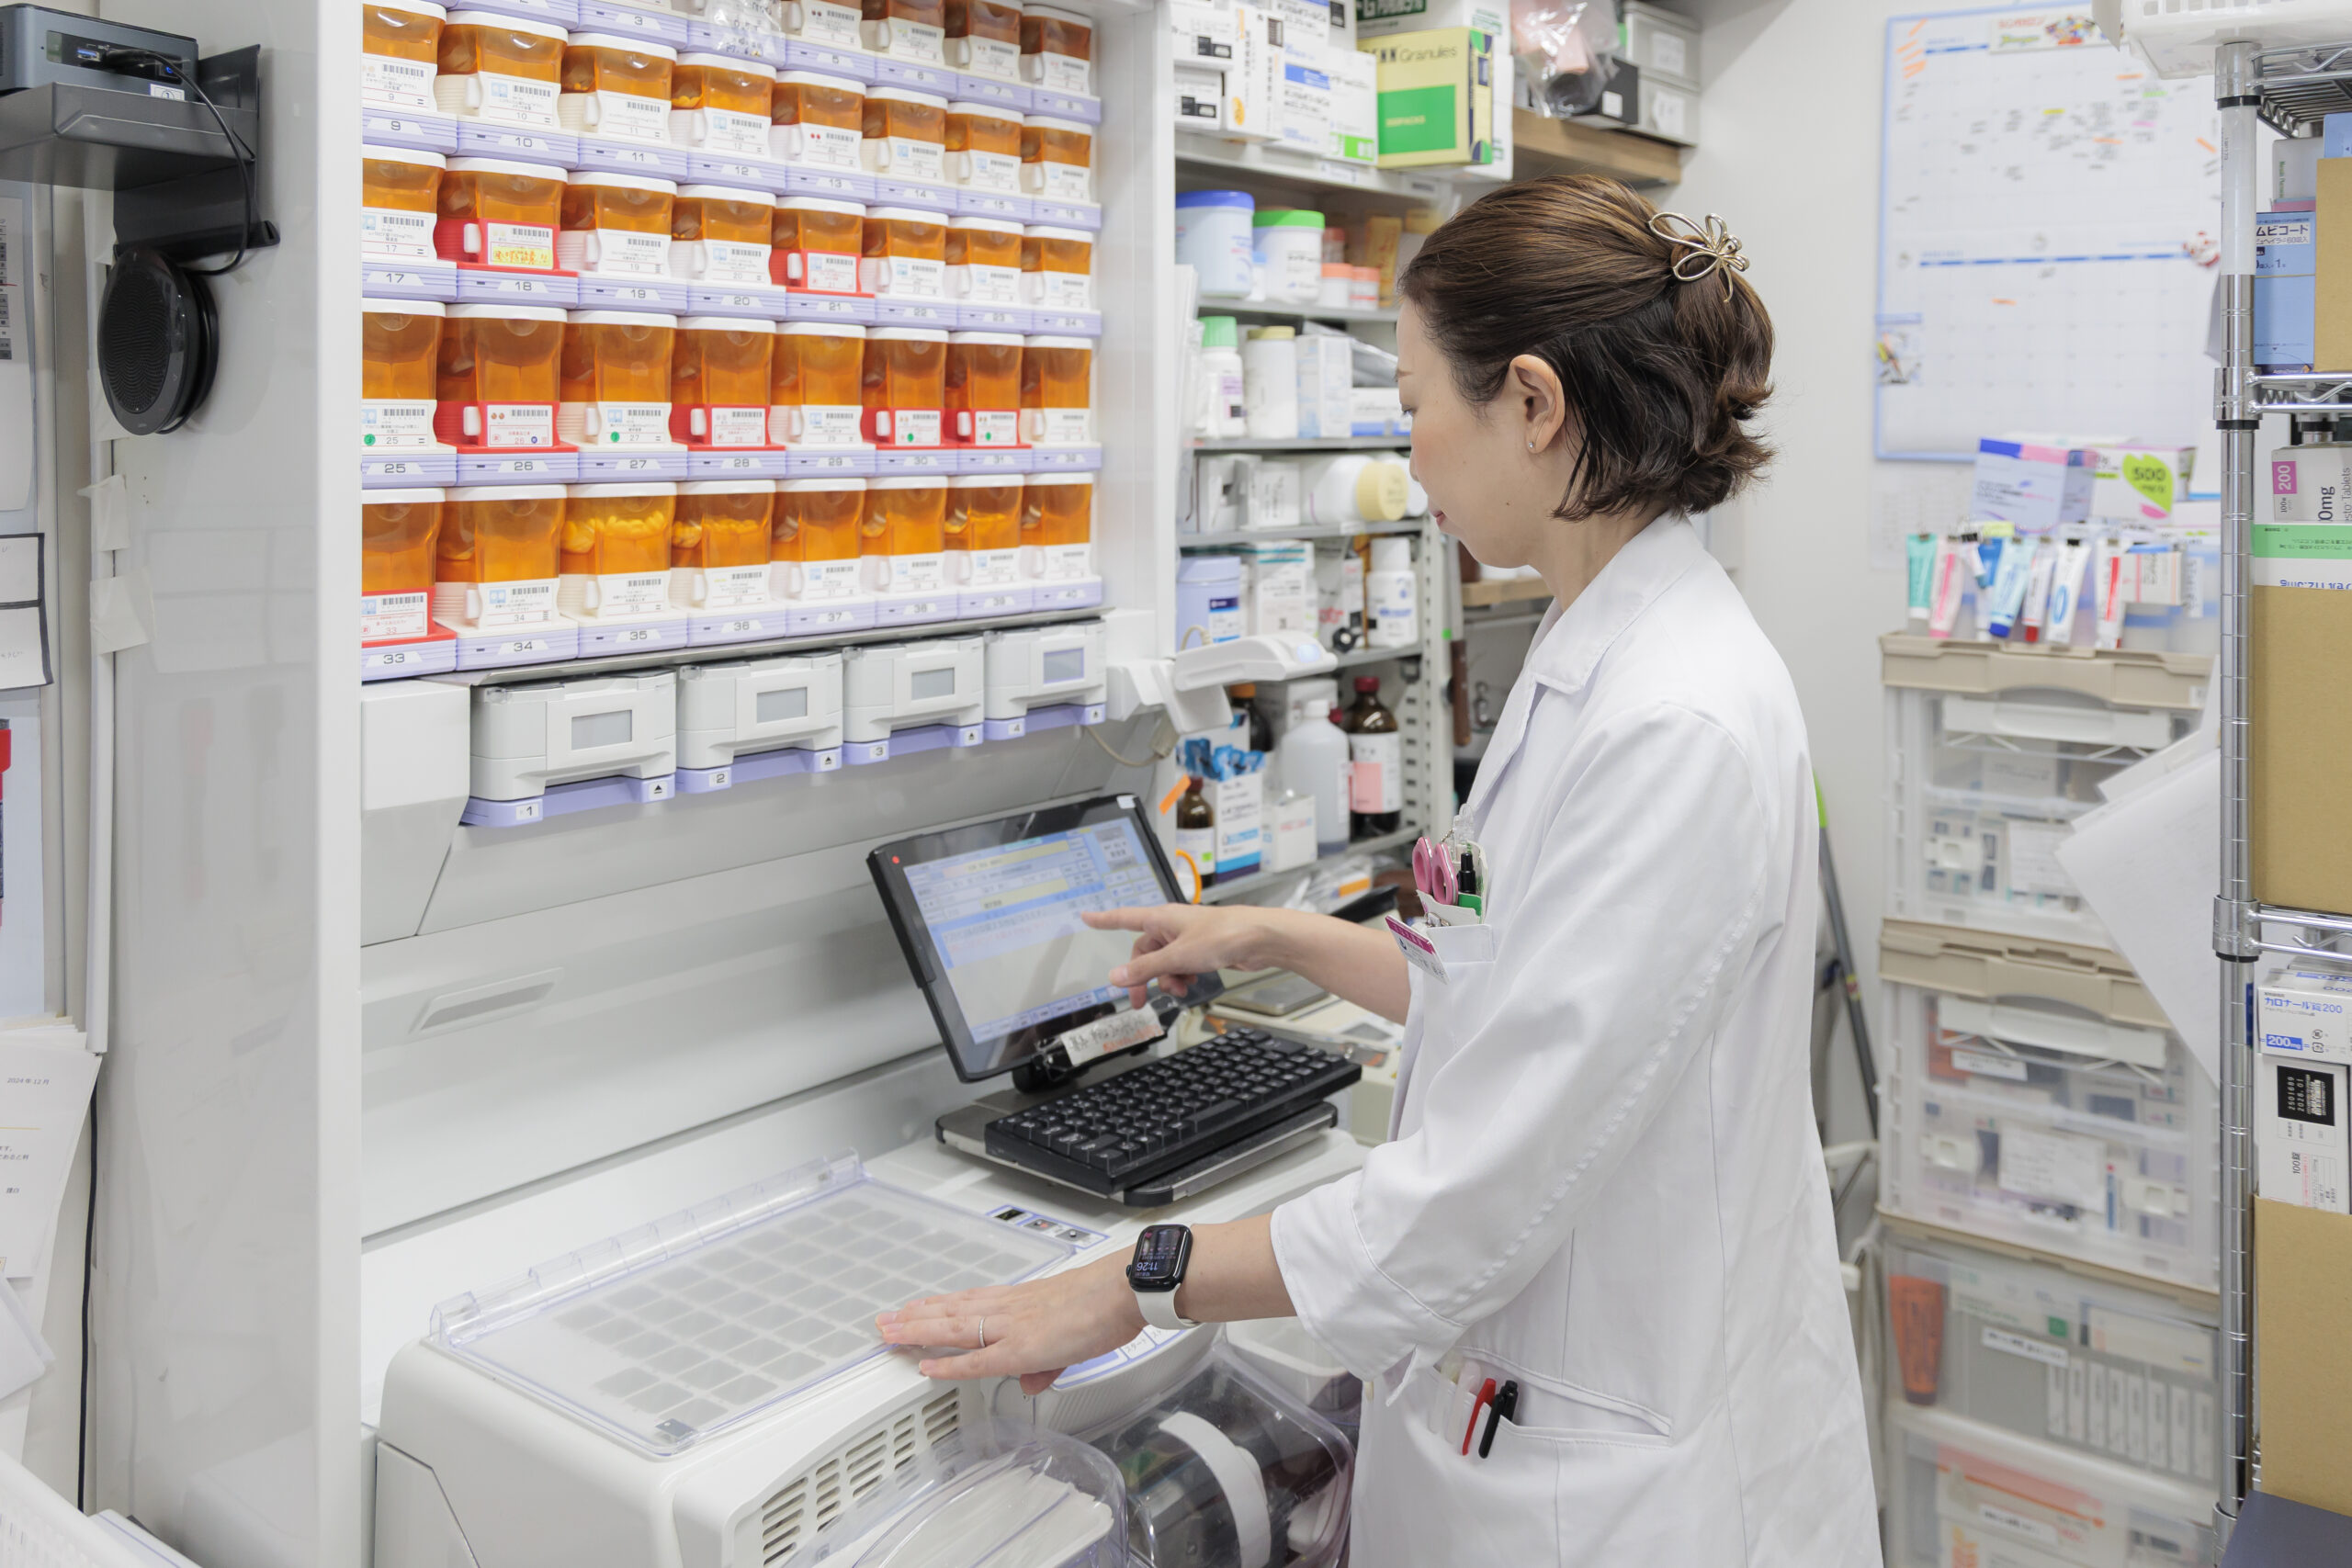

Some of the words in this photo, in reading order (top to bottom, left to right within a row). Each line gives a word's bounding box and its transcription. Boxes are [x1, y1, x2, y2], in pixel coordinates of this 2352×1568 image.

[634, 17, 643, 25] 3
[1400, 45, 1457, 61] Granules
[832, 55, 839, 64] 5
[995, 86, 1002, 95] 7
[389, 93, 394, 101] 9
[516, 112, 527, 120] 10
[390, 120, 401, 130] 9
[514, 137, 532, 148] 10
[631, 152, 644, 162] 11
[735, 166, 749, 176] 12
[829, 178, 842, 188] 13
[913, 189, 926, 197] 14
[993, 200, 1005, 209] 15
[385, 244, 397, 253] 17
[386, 274, 405, 283] 17
[514, 281, 532, 291] 18
[630, 288, 646, 299] 19
[735, 297, 750, 306] 20
[829, 302, 841, 310] 21
[914, 308, 927, 317] 22
[993, 313, 1005, 321] 23
[386, 436, 399, 445] 25
[629, 459, 647, 468] 27
[735, 458, 750, 468] 28
[829, 457, 842, 467] 29
[914, 457, 928, 465] 30
[994, 456, 1004, 464] 31
[385, 463, 406, 473] 25
[514, 461, 533, 471] 26
[2132, 468, 2166, 481] 500
[2278, 465, 2291, 491] 200
[2342, 468, 2351, 501] Tablets
[2317, 486, 2335, 521] 0mg
[993, 597, 1005, 605] 39
[914, 604, 927, 613] 38
[514, 614, 525, 622] 34
[828, 612, 842, 622] 37
[386, 626, 397, 635] 33
[734, 622, 750, 631] 36
[629, 631, 648, 640] 35
[514, 641, 533, 651] 34
[383, 653, 406, 664] 33
[1014, 723, 1021, 732] 4
[876, 747, 883, 756] 3
[717, 773, 725, 784] 2
[526, 806, 532, 816] 1
[2264, 997, 2343, 1014] カロナール錠200
[2268, 1035, 2301, 1049] 200mg
[1136, 1261, 1158, 1271] 11:26
